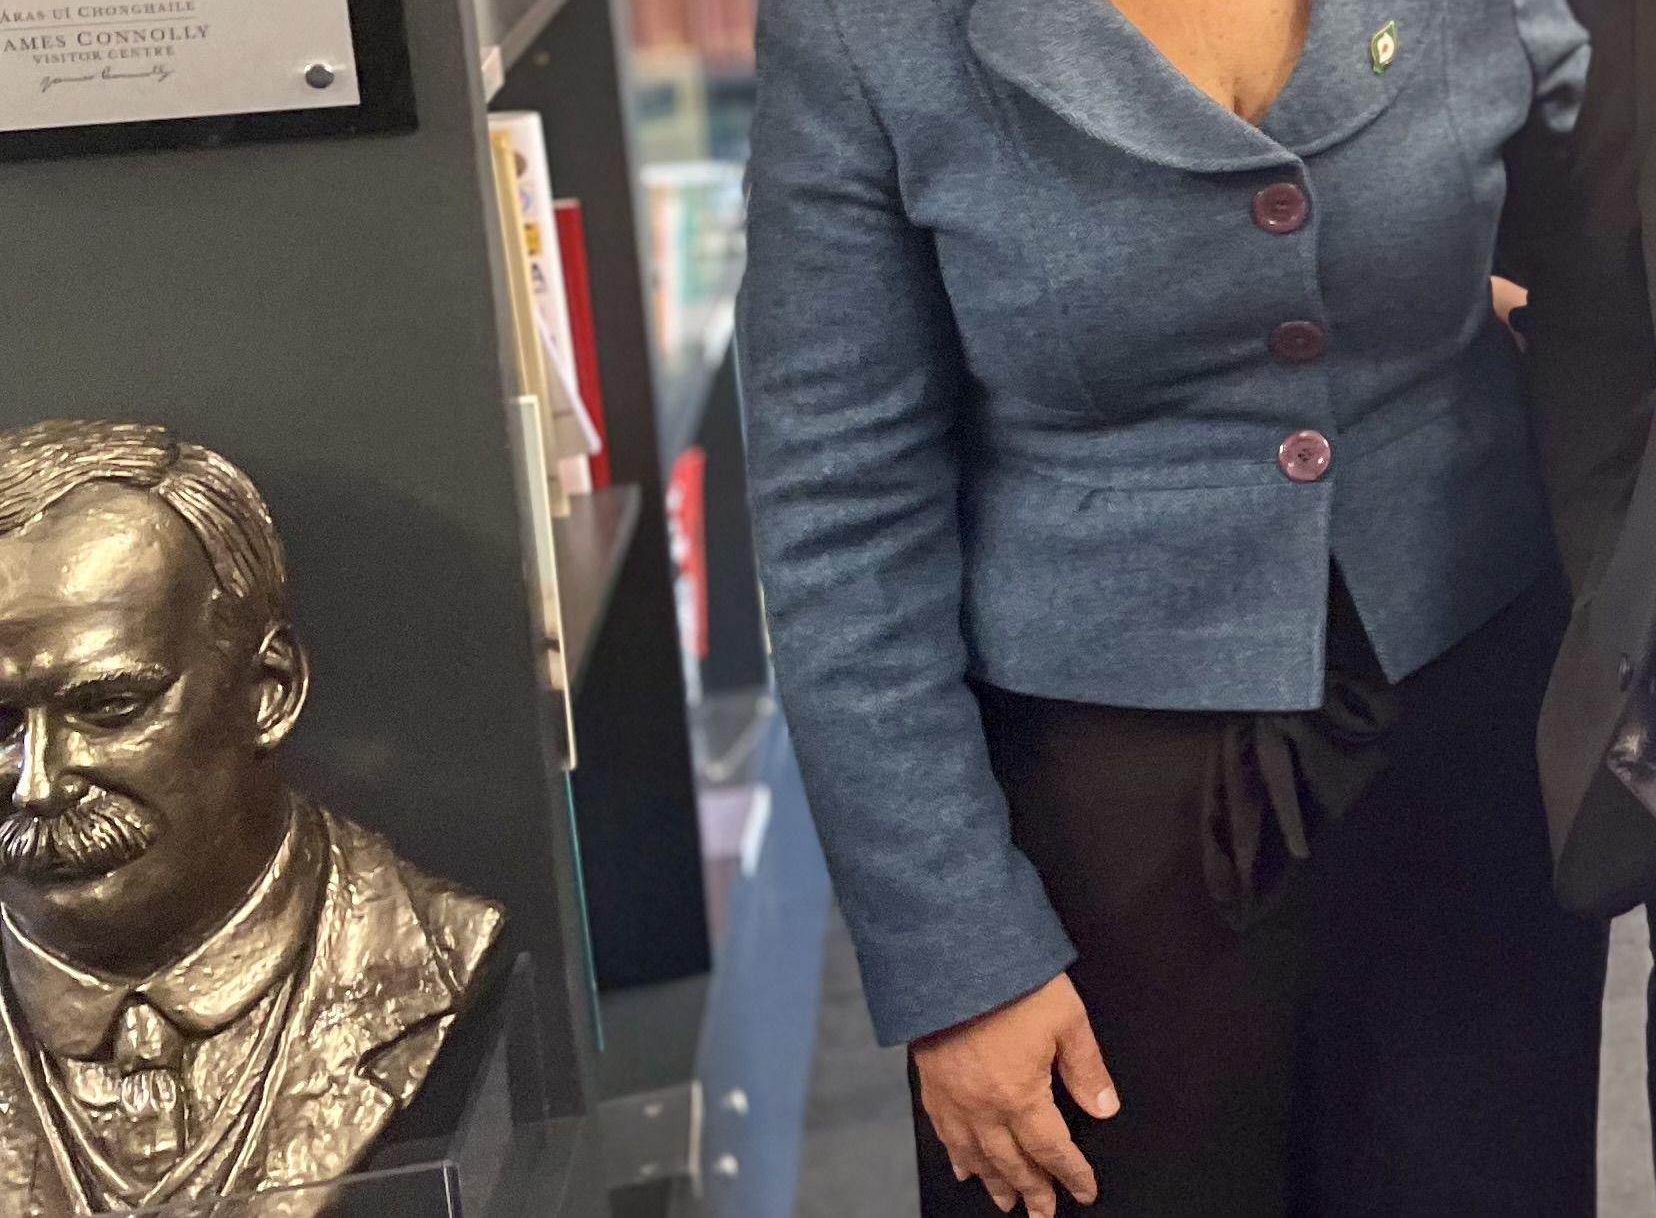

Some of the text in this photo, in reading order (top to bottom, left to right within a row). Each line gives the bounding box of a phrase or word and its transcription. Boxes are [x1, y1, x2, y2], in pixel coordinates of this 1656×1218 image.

[77, 0, 196, 18] CHONGHAILE
[76, 25, 212, 47] CONNOLLY
[32, 45, 176, 64] VISITOR CENTRE
